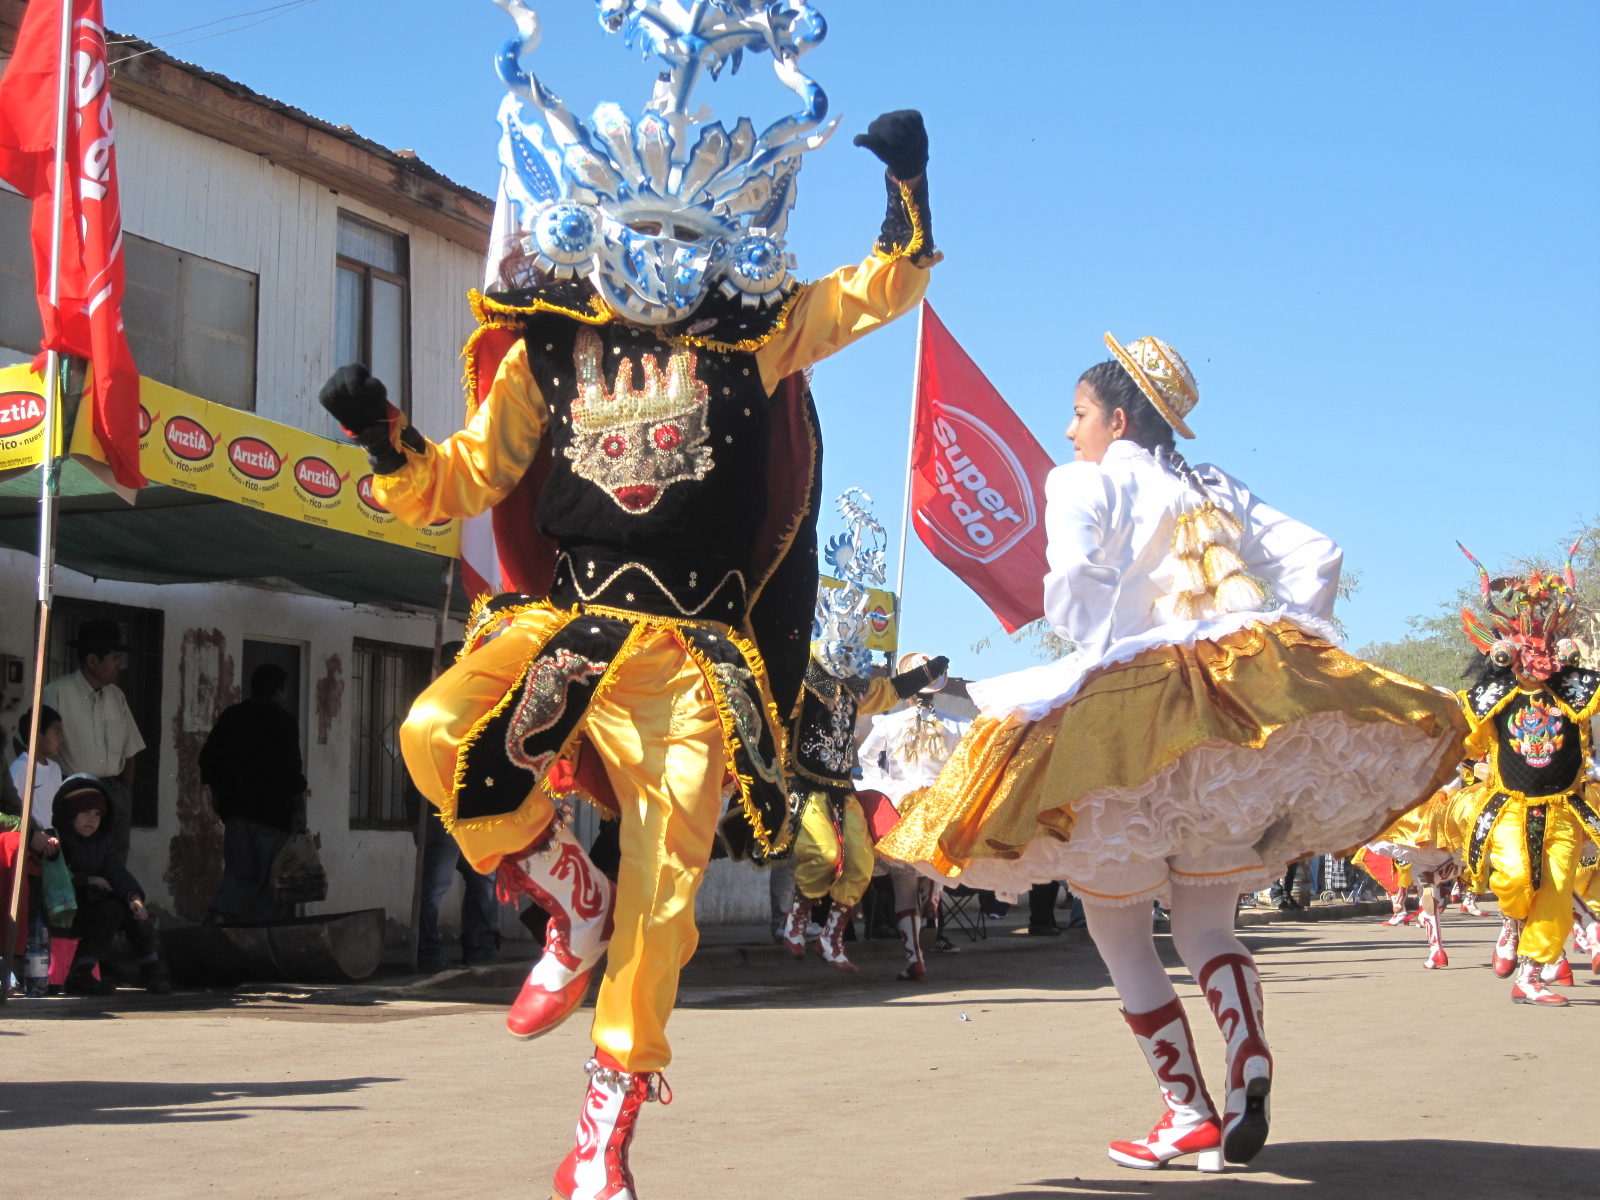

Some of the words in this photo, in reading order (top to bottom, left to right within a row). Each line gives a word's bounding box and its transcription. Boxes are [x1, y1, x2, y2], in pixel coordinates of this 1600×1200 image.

[24, 426, 46, 446] nuestr
[176, 460, 190, 472] rico
[245, 479, 259, 491] rico
[293, 486, 306, 502] fresco
[309, 497, 322, 509] rico
[933, 446, 995, 546] erdo
[356, 503, 370, 518] fresco
[372, 513, 384, 524] rico
